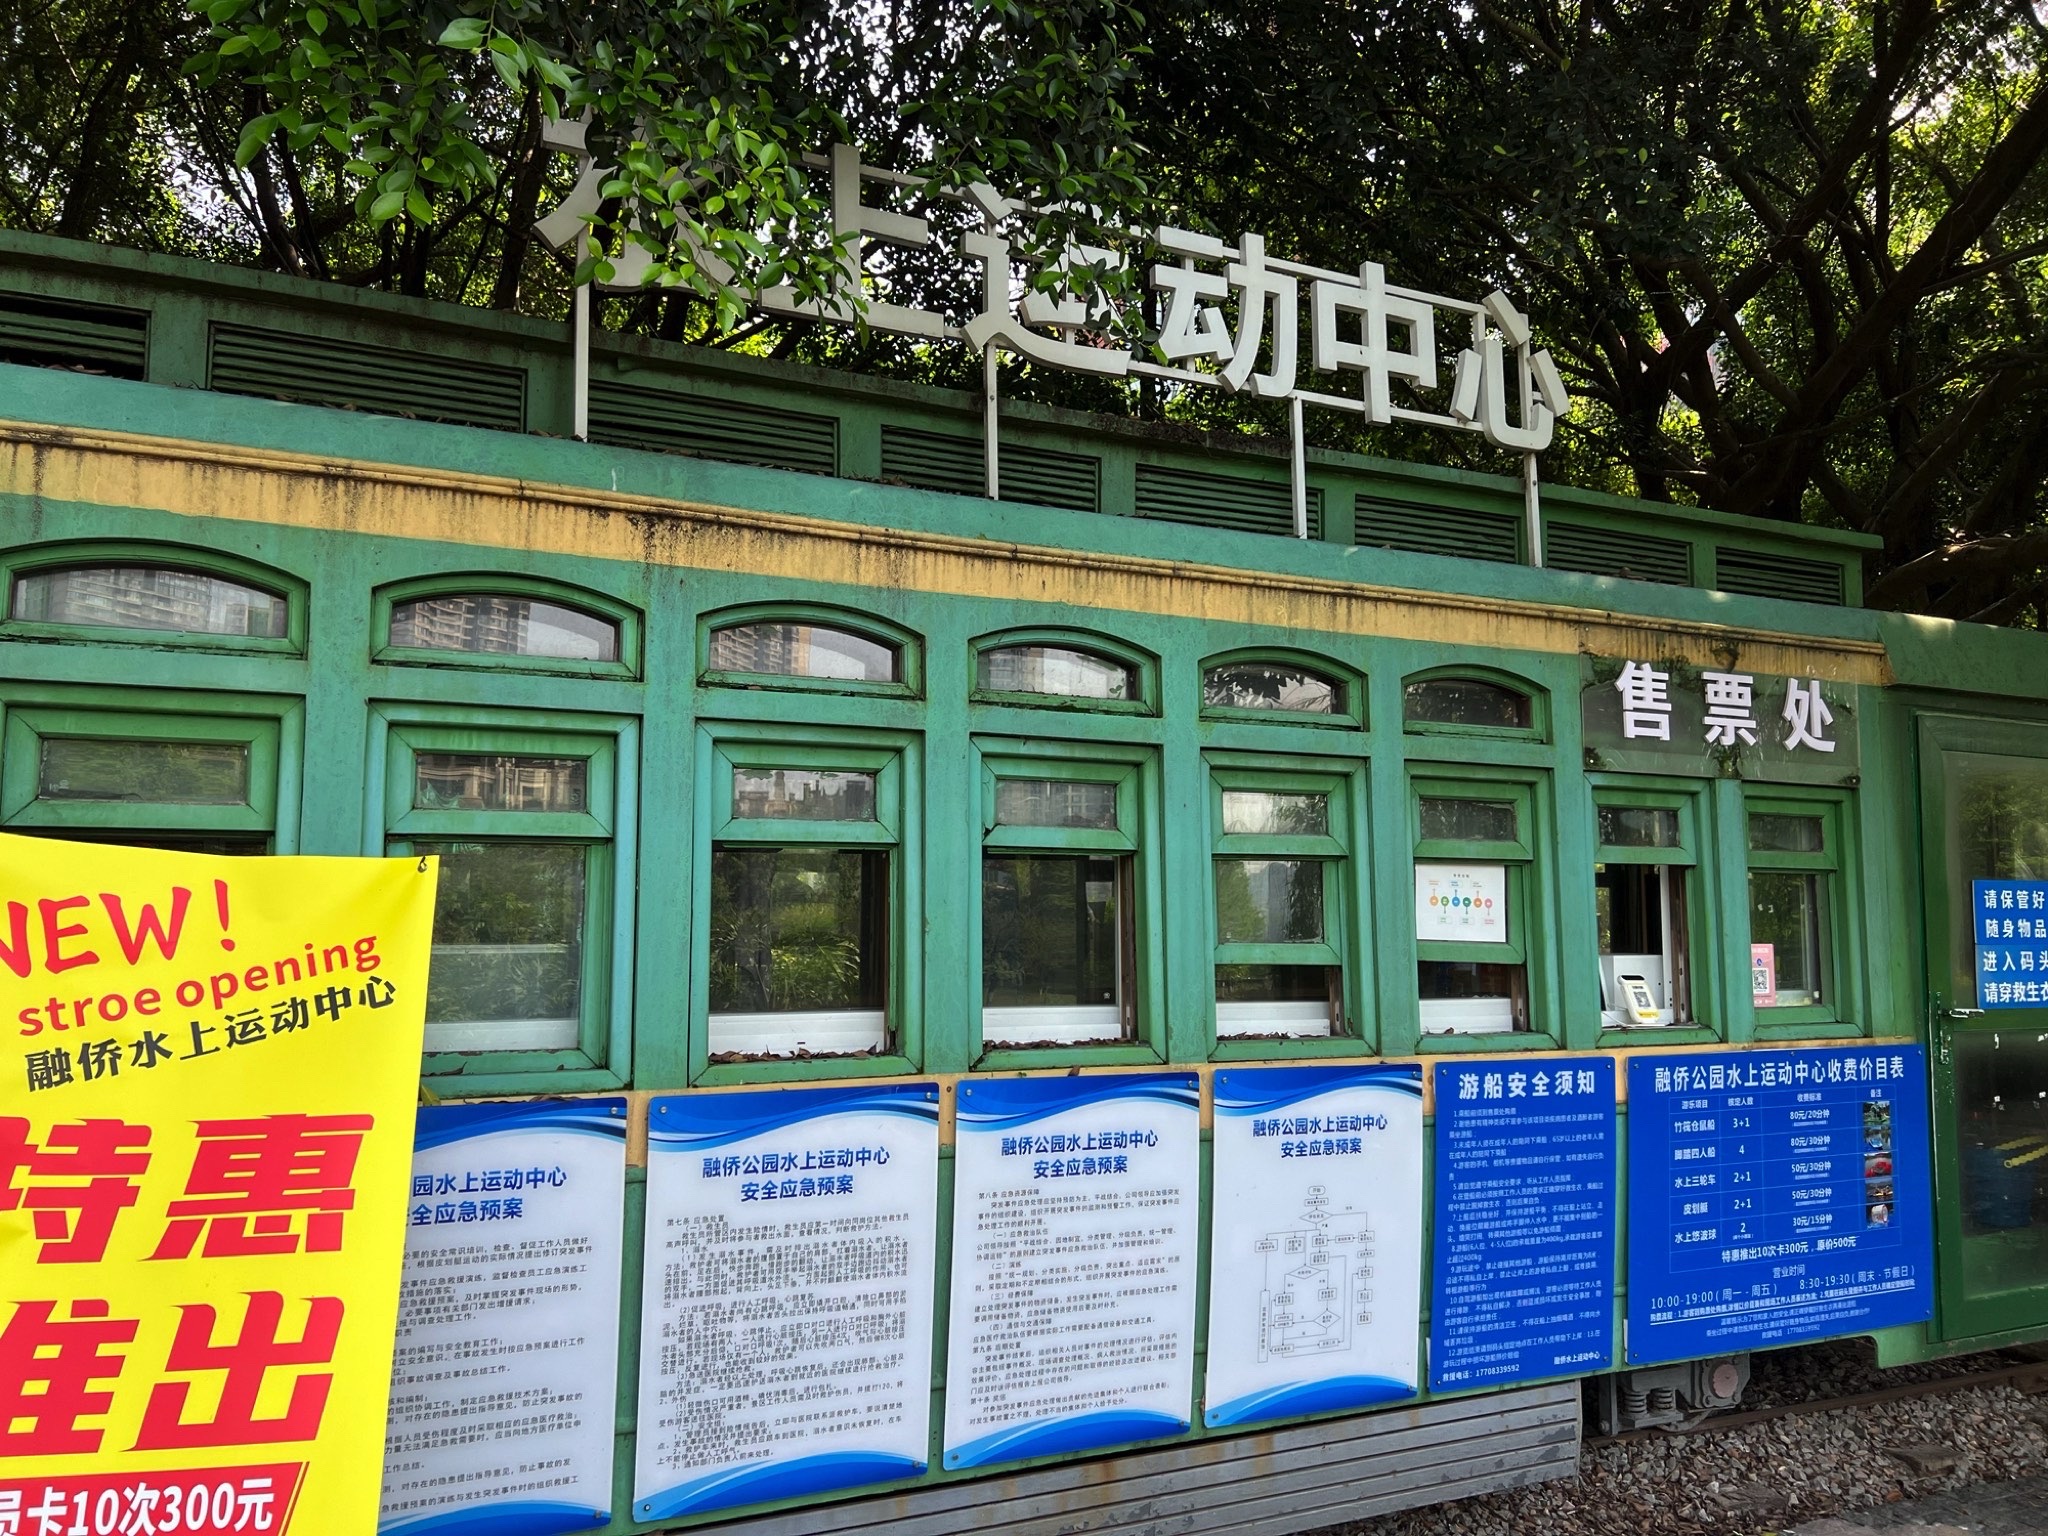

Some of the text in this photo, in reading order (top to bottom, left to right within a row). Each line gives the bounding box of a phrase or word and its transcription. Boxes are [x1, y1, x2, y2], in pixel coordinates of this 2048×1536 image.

[1614, 659, 1836, 754] 售票处
[1983, 889, 2045, 910] 请保管好
[1985, 918, 2047, 939] 随身物品
[18, 935, 383, 1037] stroe opening
[25, 975, 398, 1093] 融侨水上运动中心
[1458, 1068, 1595, 1101] 游船安全须知
[1655, 1056, 1904, 1093] 融侨公园水上运动中心收费价目表
[1253, 1114, 1388, 1137] 融侨公园水上运动中心
[1733, 1118, 1750, 1128] 3+1
[1790, 1109, 1830, 1120] 80元/20分钟
[1001, 1128, 1158, 1157] 融侨公园水上运动中心
[1281, 1138, 1362, 1158] 安全应急预案
[1739, 1145, 1744, 1155] 4
[1791, 1136, 1830, 1147] 80元/30分钟
[702, 1145, 890, 1178] 融侨公园水上运动中心
[1033, 1154, 1128, 1179] 安全应急预案
[1675, 1161, 1831, 1188] 水上三轮车 2+1 50元/30分钟
[0, 1113, 375, 1264] 特惠
[740, 1175, 853, 1202] 安全应急预案
[1683, 1188, 1832, 1215] 皮划艇 2+1 50元/30分钟
[407, 1196, 523, 1227] 全应急预案
[1740, 1223, 1746, 1232] 2
[1793, 1214, 1832, 1226] 30元/15分钟
[1772, 1264, 1805, 1278] 营业时间
